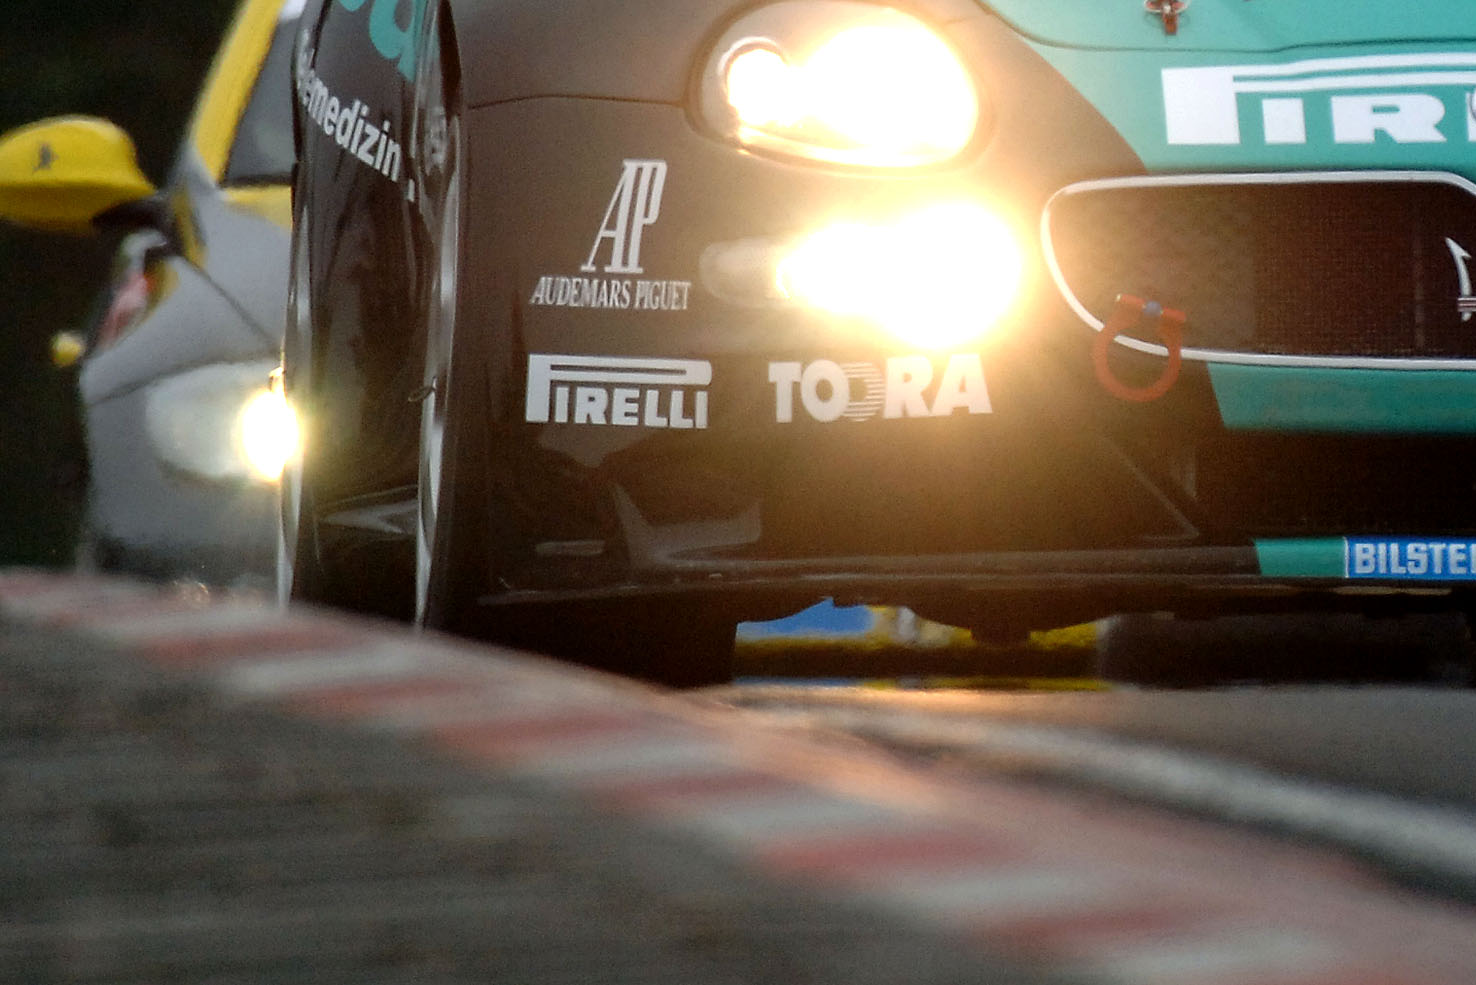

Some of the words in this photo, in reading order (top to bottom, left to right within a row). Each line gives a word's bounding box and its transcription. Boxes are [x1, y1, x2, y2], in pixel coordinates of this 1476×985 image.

[580, 159, 667, 273] AP
[531, 277, 630, 309] AUDEMARS
[635, 281, 691, 311] PIGUET
[526, 354, 712, 428] PIRELLI
[769, 354, 992, 423] TOORA
